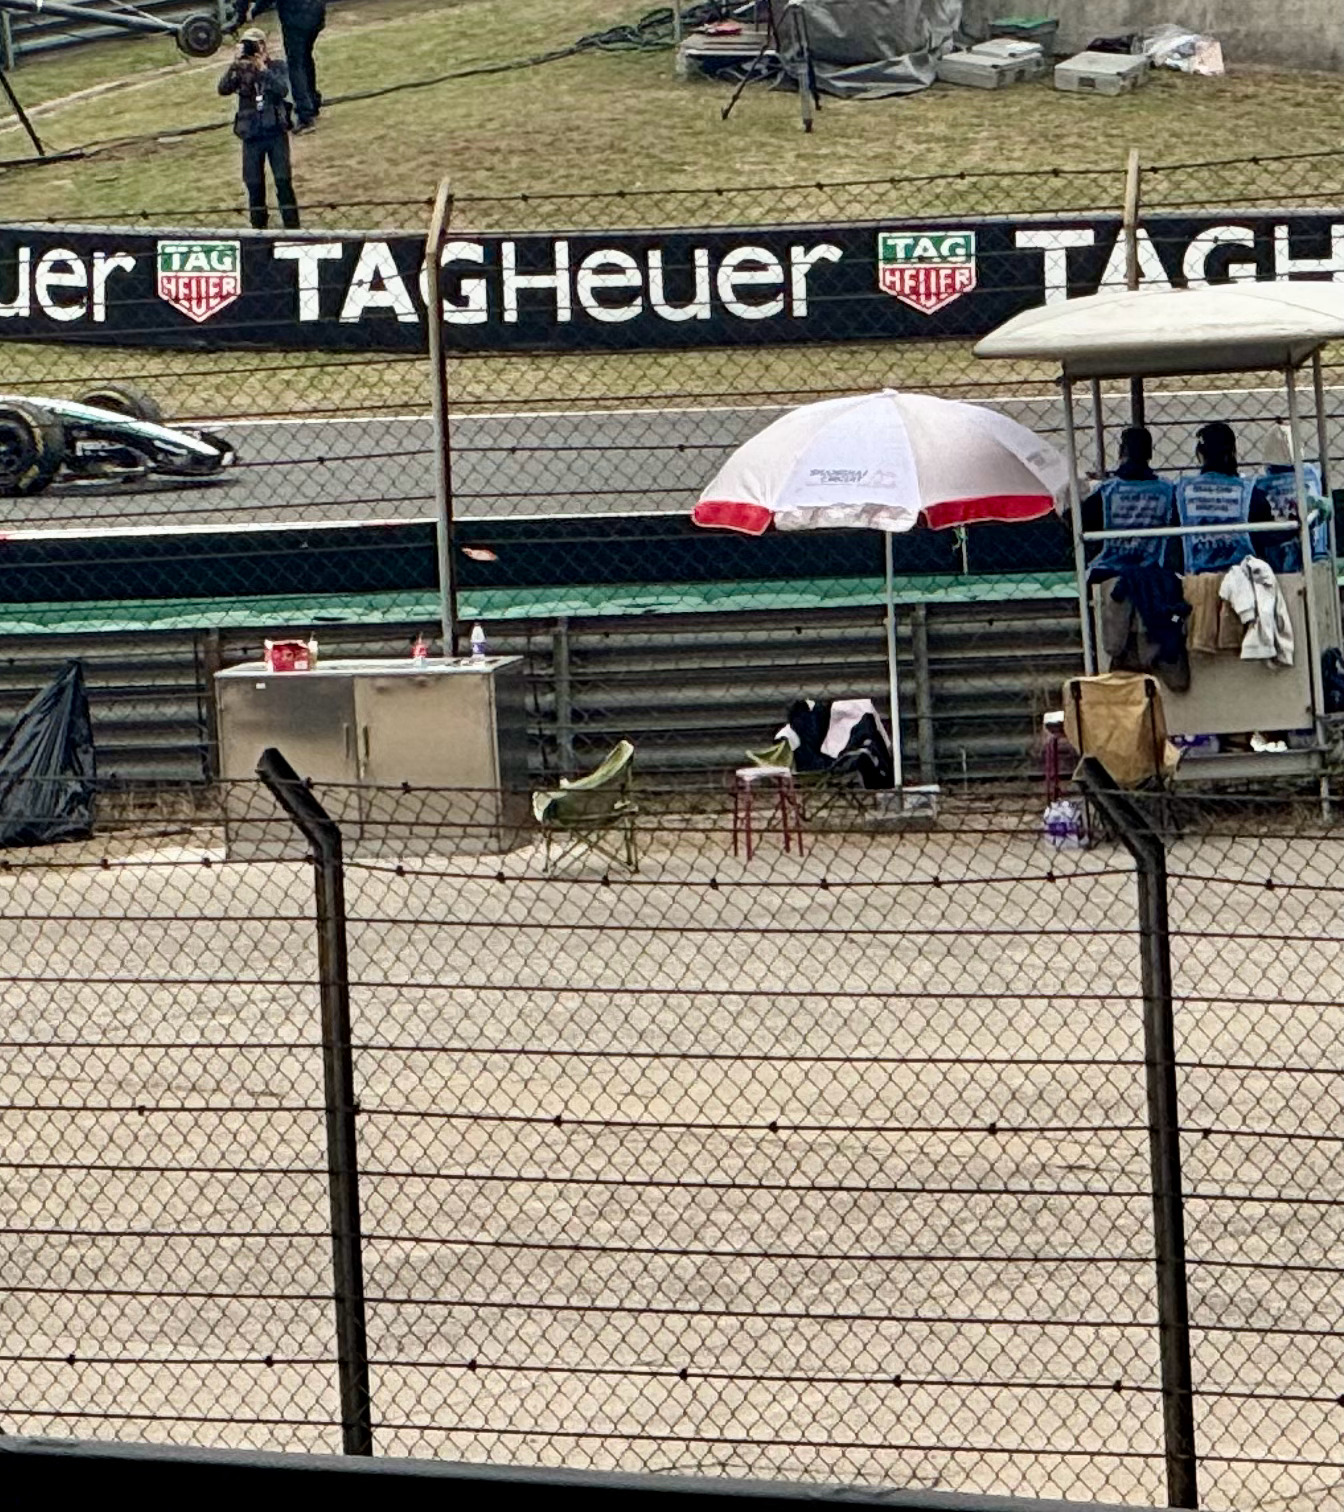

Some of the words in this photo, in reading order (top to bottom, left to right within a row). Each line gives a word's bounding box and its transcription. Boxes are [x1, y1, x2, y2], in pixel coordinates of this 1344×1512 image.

[165, 246, 232, 271] TAG
[887, 238, 967, 262] TAG
[163, 276, 237, 312] HEUER
[274, 241, 841, 323] TAGHeuer
[884, 268, 969, 306] HEUER
